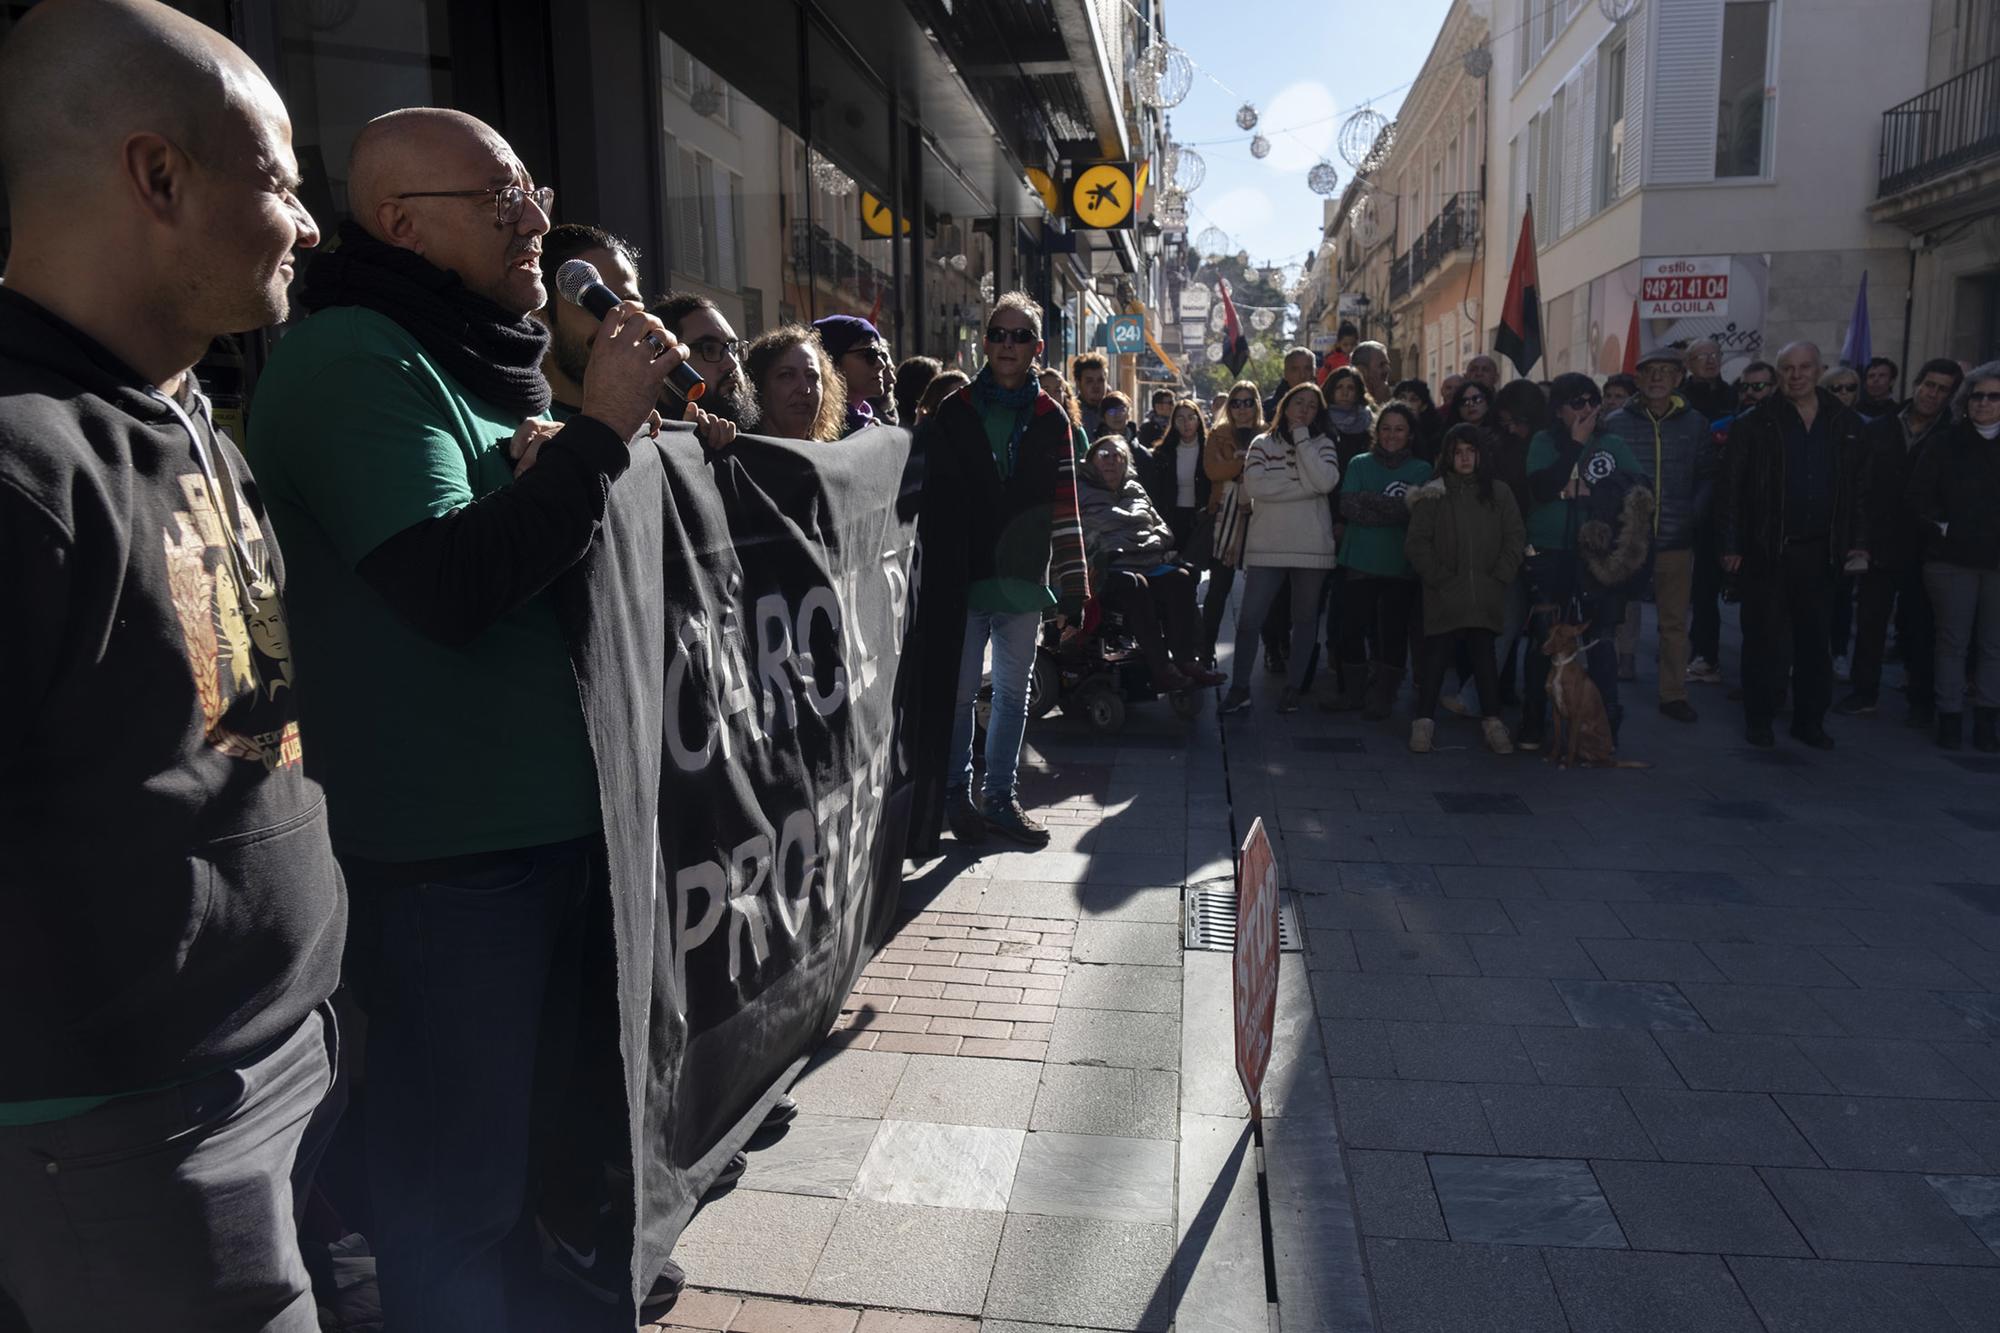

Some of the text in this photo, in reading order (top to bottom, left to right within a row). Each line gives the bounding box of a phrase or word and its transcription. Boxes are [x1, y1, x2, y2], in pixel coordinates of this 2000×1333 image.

[1658, 261, 1696, 274] estilo
[1645, 278, 1725, 299] 949 21 41 04
[1653, 302, 1715, 313] ALQUILA
[1238, 862, 1275, 1027] STOP
